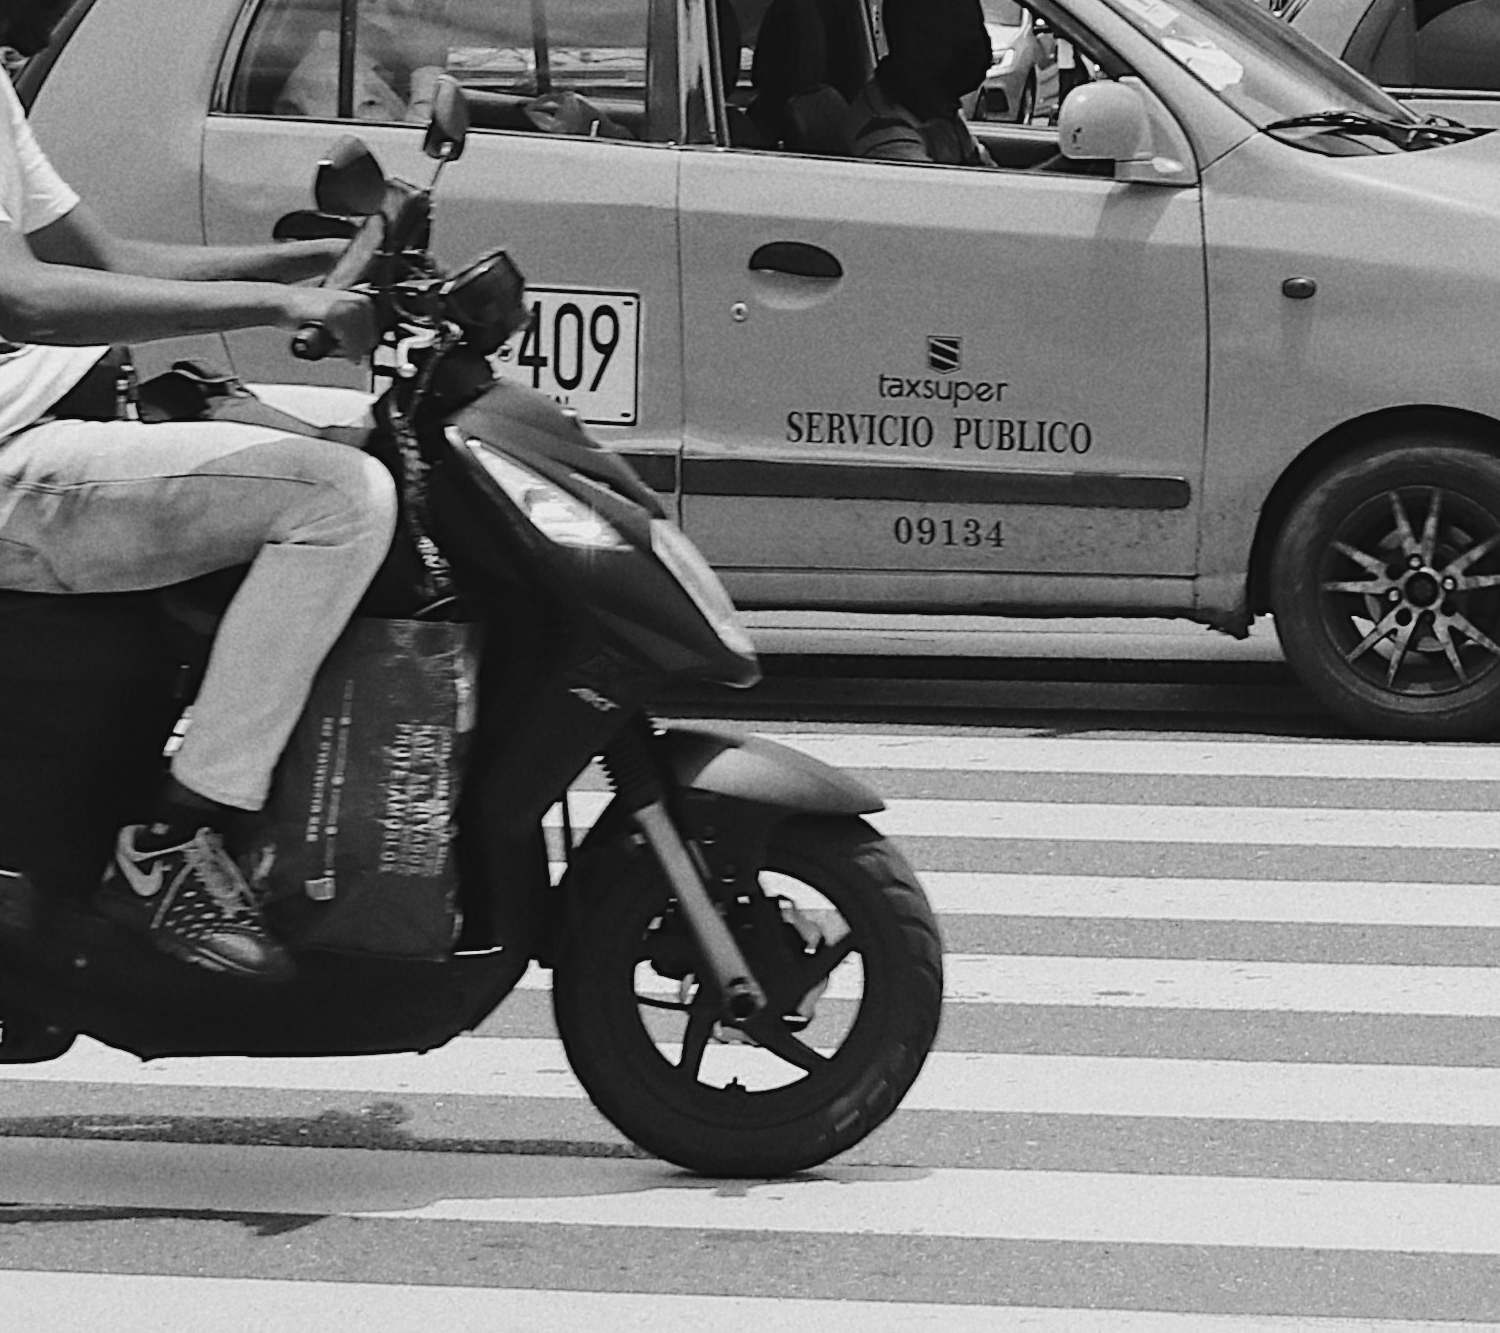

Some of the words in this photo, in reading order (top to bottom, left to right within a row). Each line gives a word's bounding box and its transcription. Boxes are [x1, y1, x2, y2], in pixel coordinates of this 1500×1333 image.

[879, 373, 1010, 408] taxsuper
[786, 411, 934, 448] SERVICIO
[953, 417, 1092, 454] PUBLICO
[894, 516, 1005, 547] 09134
